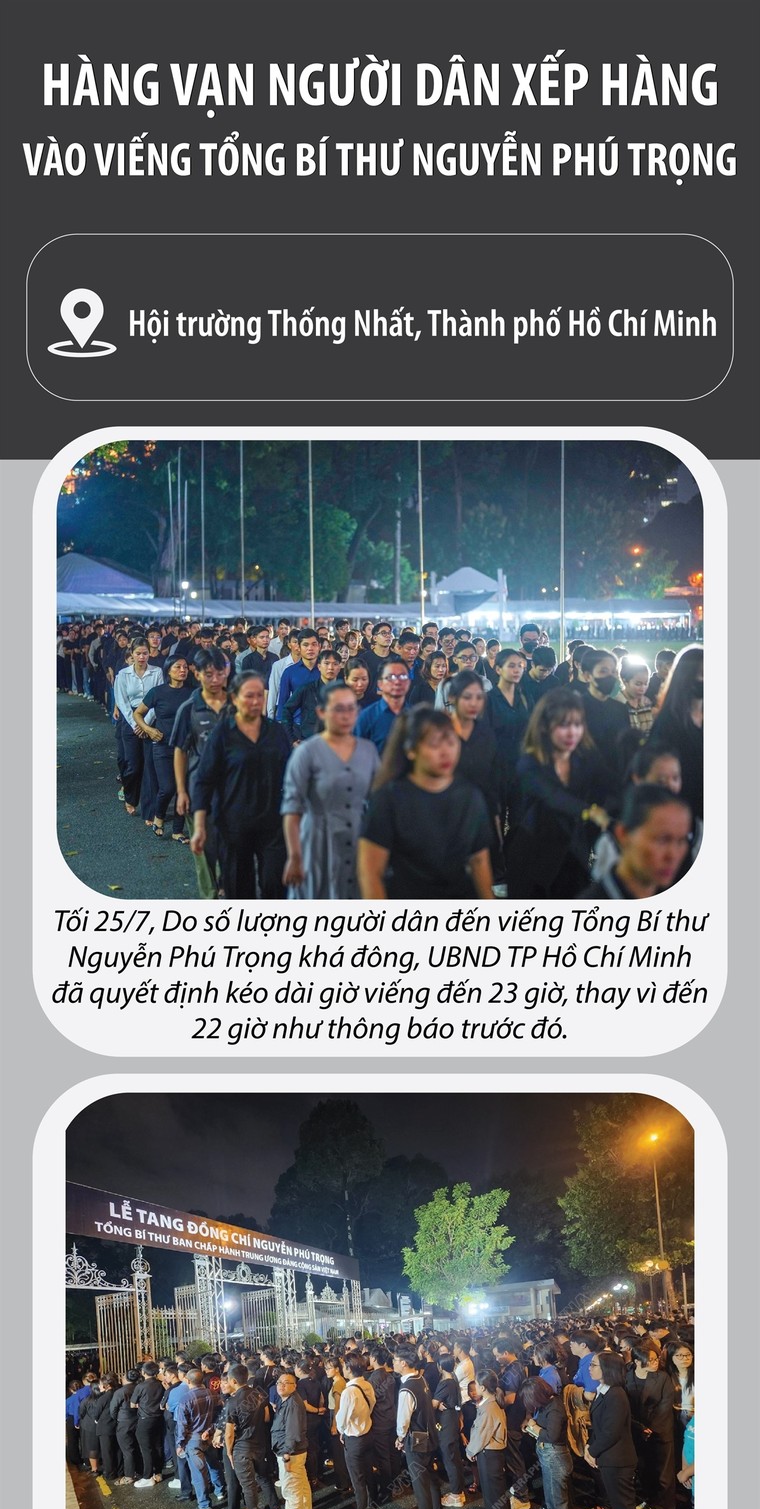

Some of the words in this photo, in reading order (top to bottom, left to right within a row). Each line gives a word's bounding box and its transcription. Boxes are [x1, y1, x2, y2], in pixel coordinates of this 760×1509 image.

[95, 1221, 132, 1238] TỔNG
[135, 1229, 146, 1240] BÍ
[147, 1232, 171, 1244] THƯ
[172, 1237, 193, 1248] BAN
[241, 1250, 264, 1262] TRUNG
[109, 1200, 133, 1221] LỄ
[136, 1208, 184, 1232] TANG
[187, 1220, 229, 1242] ĐỒNG
[231, 1232, 251, 1247] CHÍ
[253, 1238, 293, 1256] NGUYỄN
[294, 1247, 310, 1260] PHÚ
[311, 1252, 335, 1265] TRỌNG
